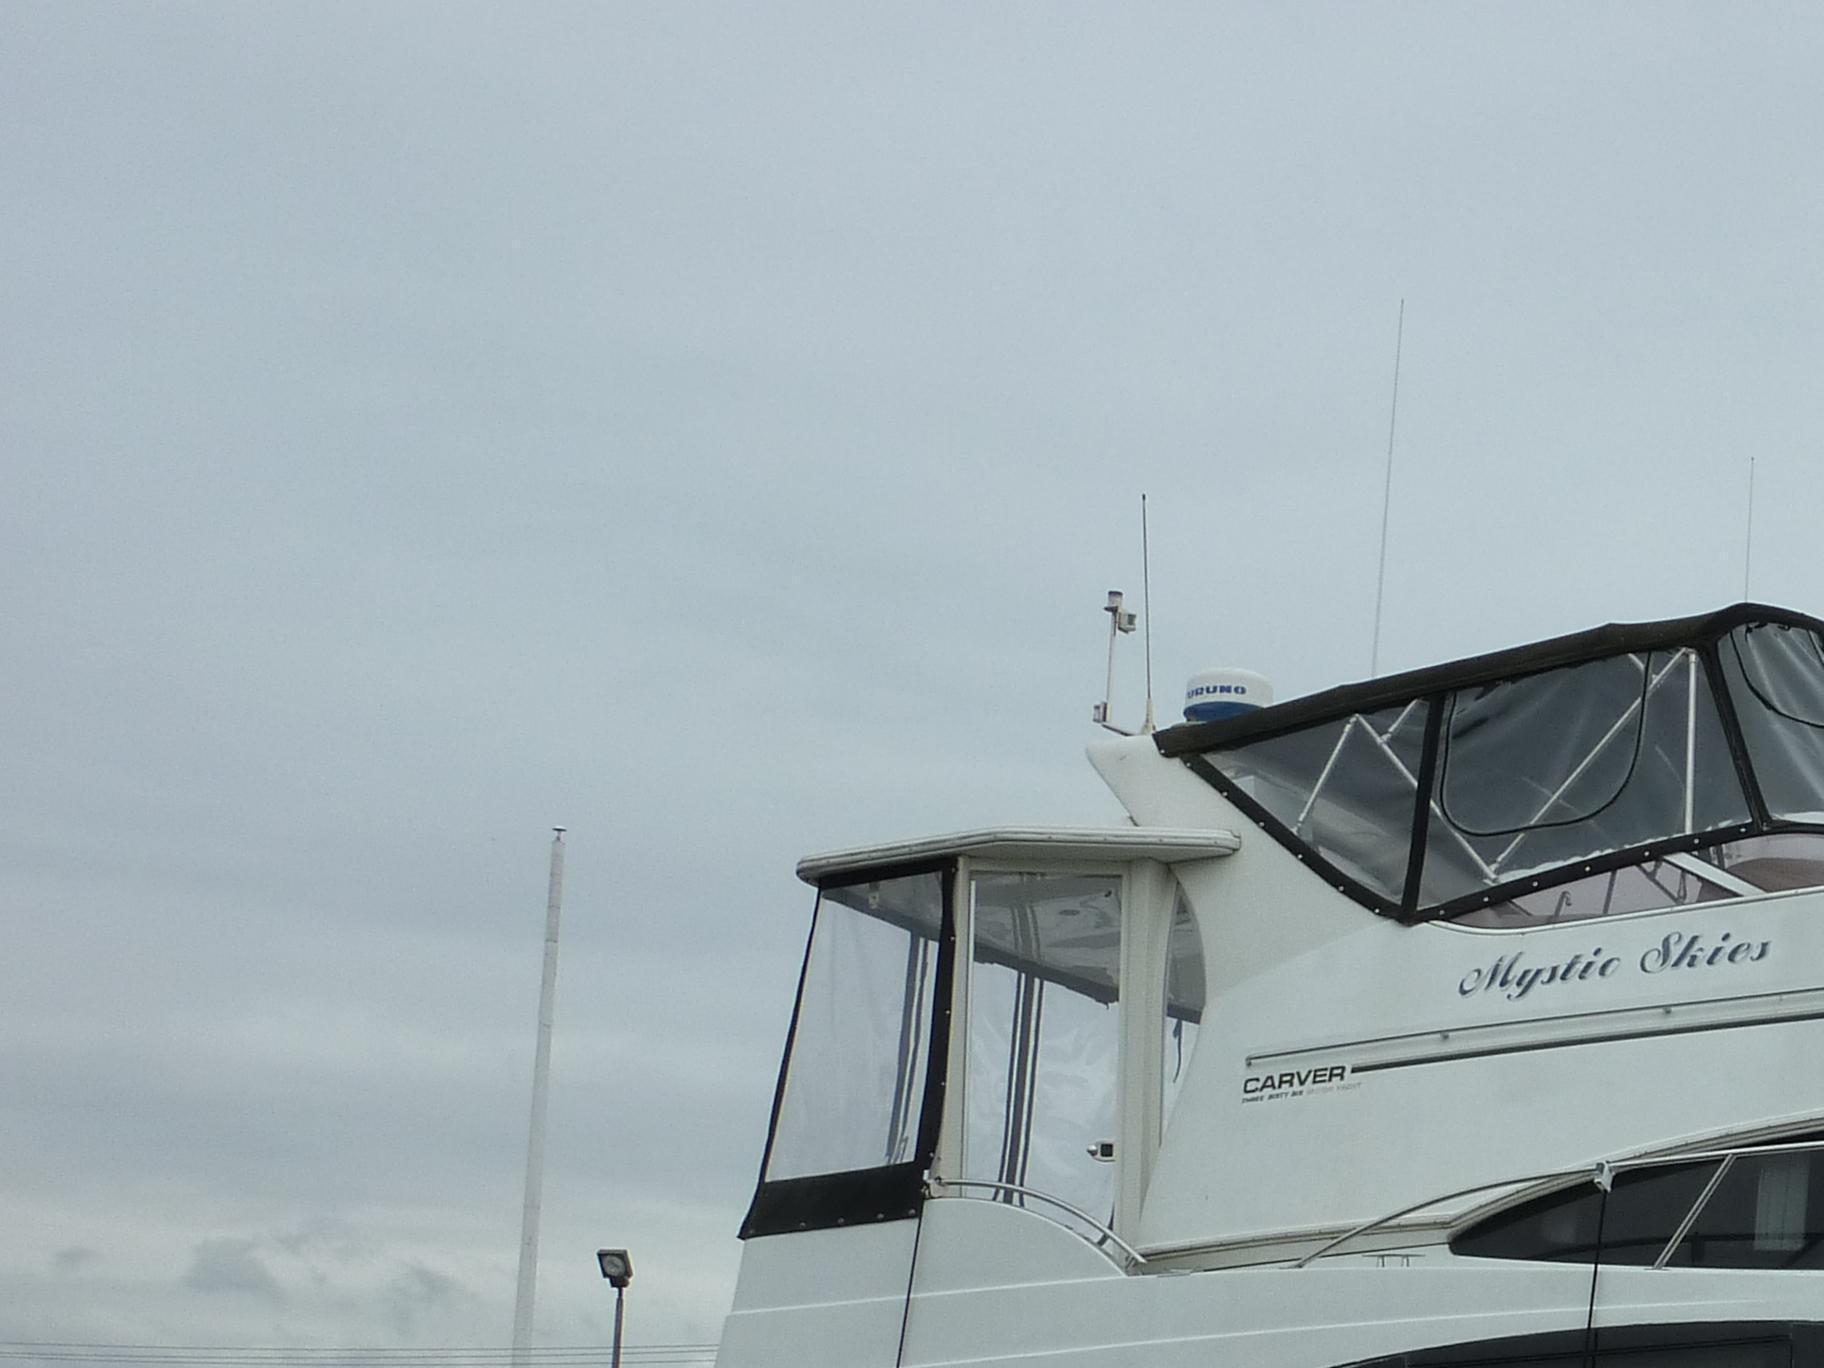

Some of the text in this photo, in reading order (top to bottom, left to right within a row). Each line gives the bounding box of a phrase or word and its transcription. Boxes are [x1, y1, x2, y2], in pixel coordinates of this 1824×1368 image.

[1186, 684, 1248, 699] URUNO
[1457, 931, 1773, 1002] Mystic Skies
[1243, 1065, 1347, 1095] CARVER
